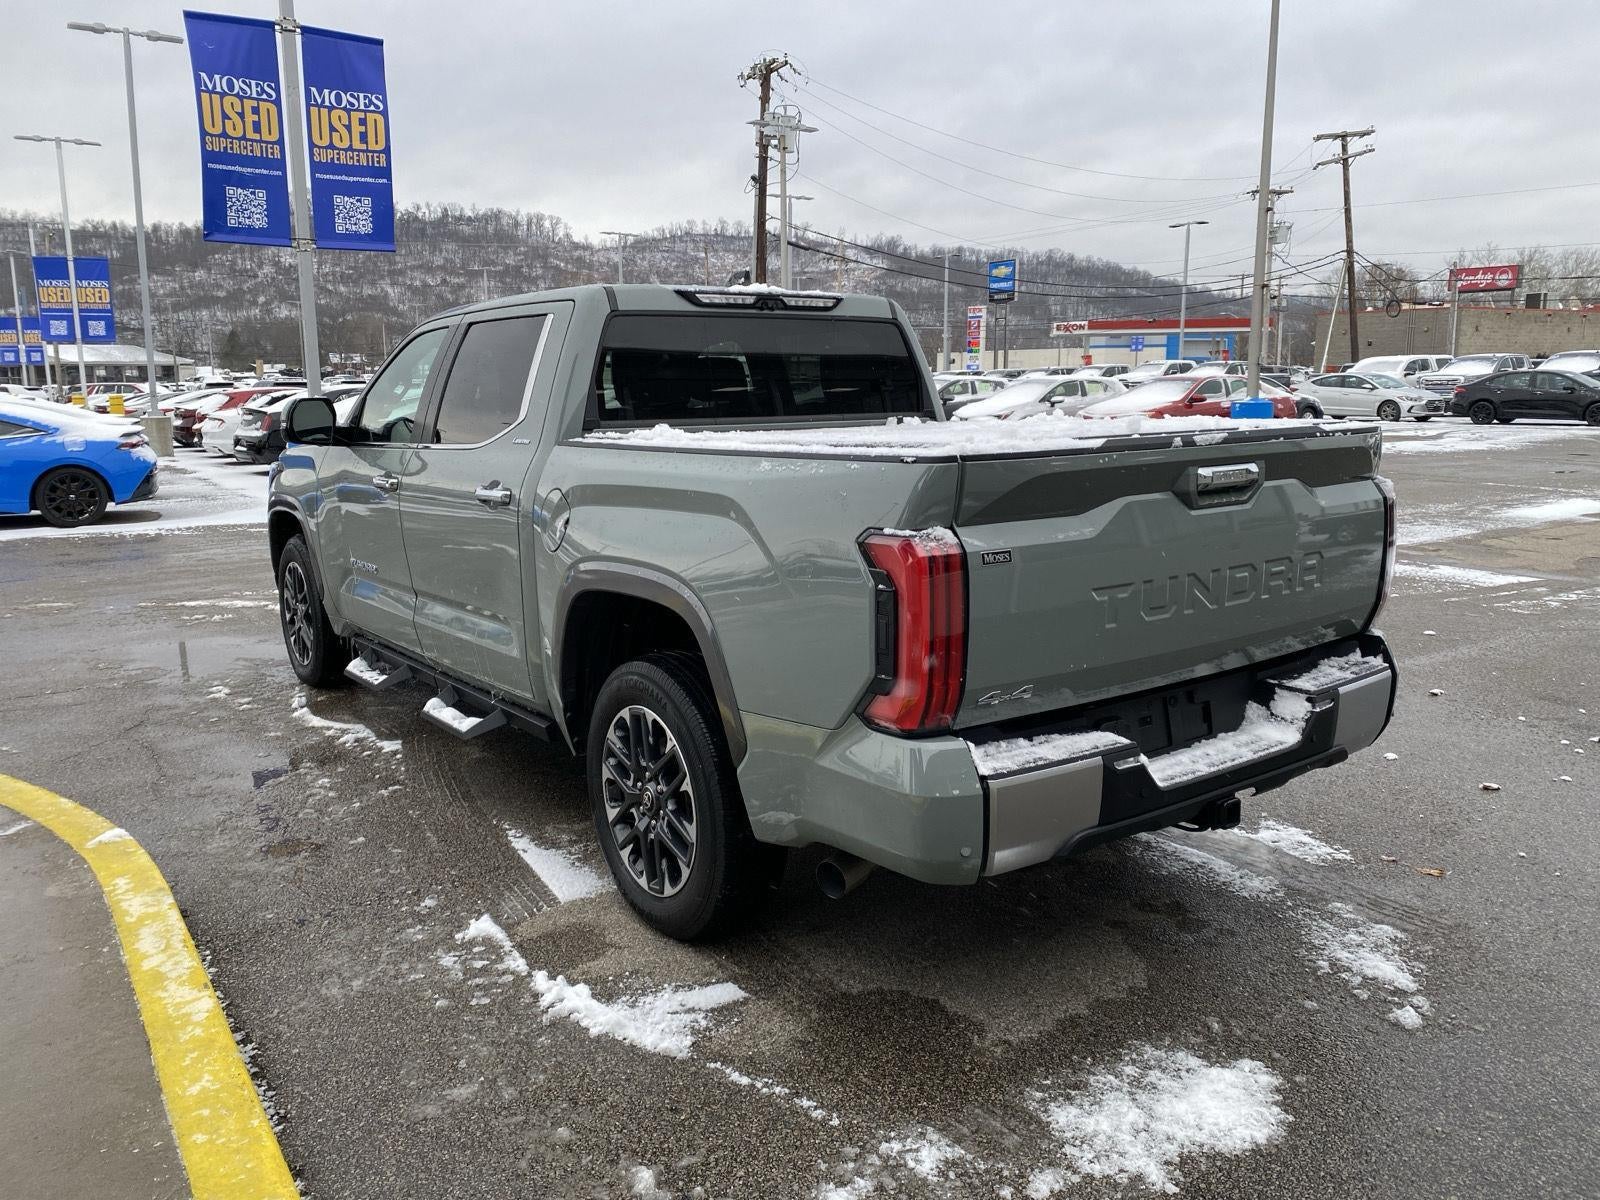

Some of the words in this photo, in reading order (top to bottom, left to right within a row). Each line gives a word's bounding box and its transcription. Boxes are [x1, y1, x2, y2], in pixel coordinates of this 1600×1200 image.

[199, 72, 276, 100] MOSES
[309, 86, 384, 111] MOSES
[200, 92, 280, 142] USED
[310, 106, 386, 151] USED
[205, 136, 281, 159] SUPERCENTER
[313, 148, 387, 168] SUPERCENTER
[207, 163, 282, 175] mosesusedsupercenter.com
[38, 279, 70, 288] MOSES
[77, 280, 109, 288] MOSES
[39, 287, 72, 303] USED
[77, 287, 110, 303] USED
[24, 333, 41, 342] USE
[1056, 323, 1085, 333] EXXON
[982, 552, 1010, 565] MOSES
[1091, 551, 1324, 628] TUNDRA
[625, 679, 669, 712] YOKOHAMA
[978, 684, 1034, 705] 4x4
